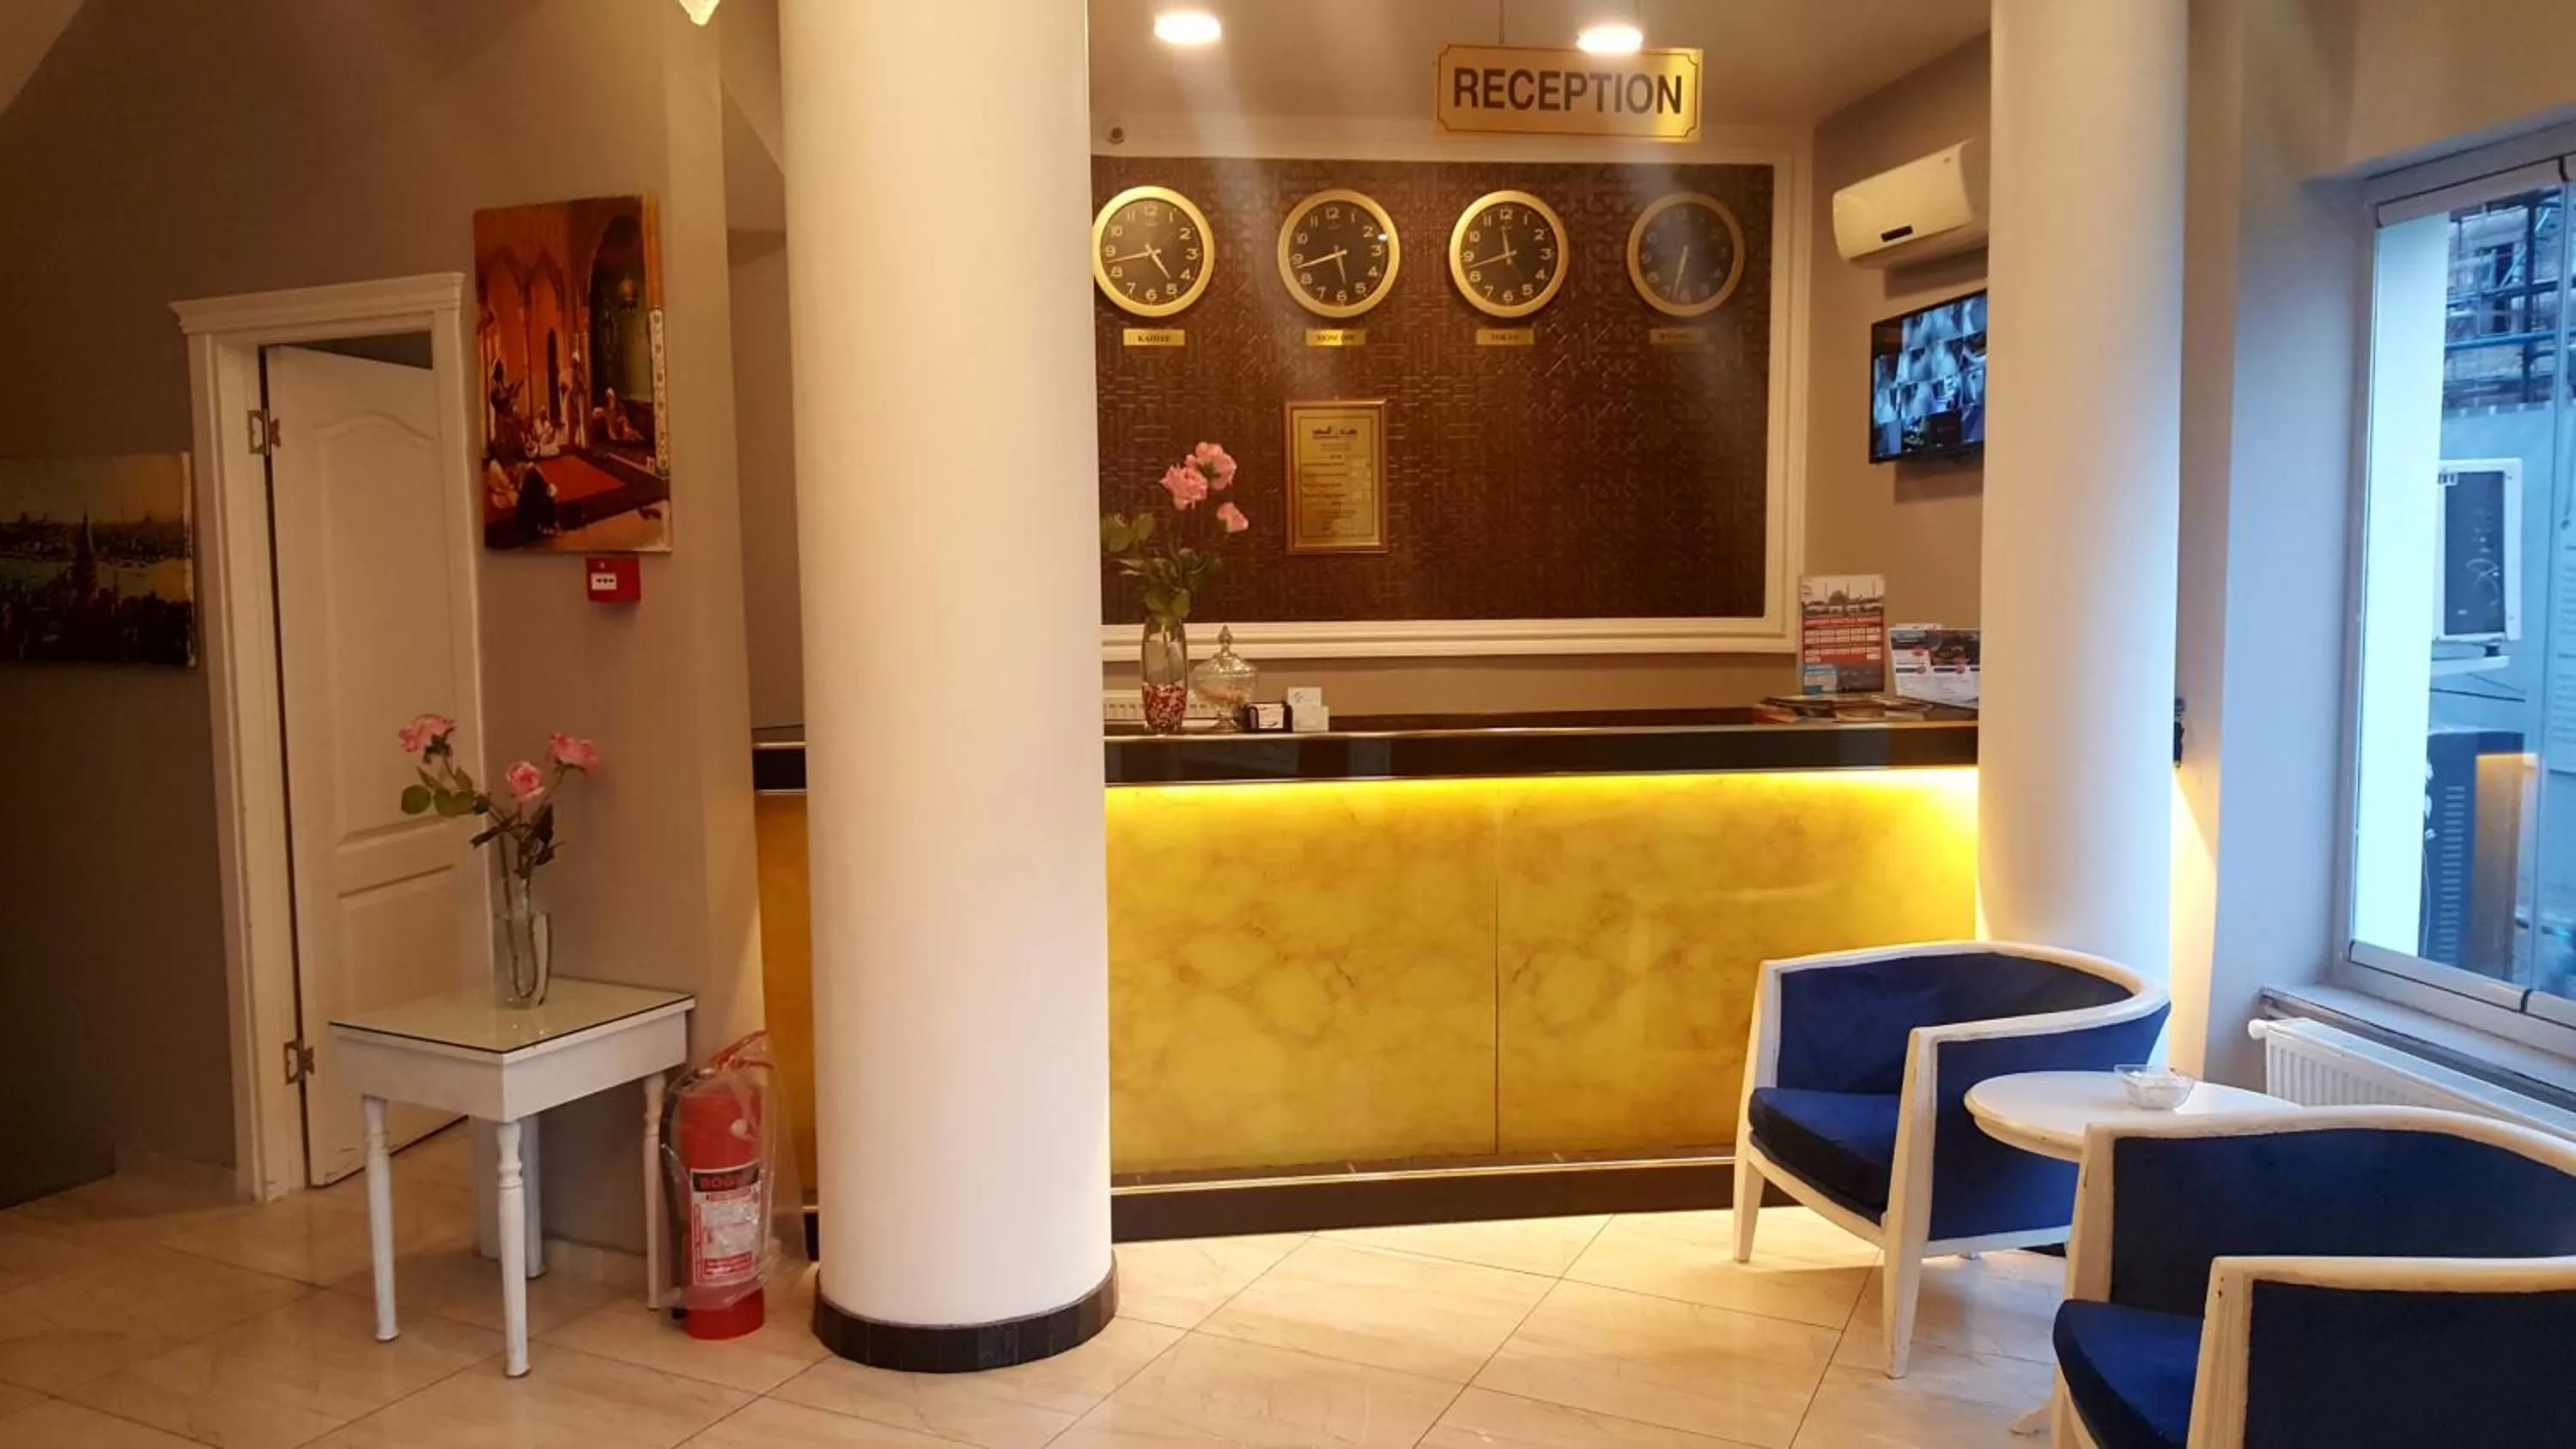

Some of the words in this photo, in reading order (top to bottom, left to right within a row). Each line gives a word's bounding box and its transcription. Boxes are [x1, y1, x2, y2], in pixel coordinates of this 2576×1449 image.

[1453, 67, 1682, 114] RECEPTION
[1326, 208, 1340, 219] 12
[1500, 209, 1512, 220] 12
[1180, 228, 1191, 239] 2
[1364, 227, 1374, 238] 2
[1469, 231, 1480, 242] 10
[1534, 229, 1544, 240] 2
[1297, 233, 1308, 245] 10
[1105, 246, 1115, 257] 9
[1187, 248, 1198, 259] 3
[1372, 246, 1382, 257] 3
[1463, 251, 1474, 262] 9
[1540, 249, 1552, 260] 3
[1291, 254, 1304, 264] 9
[1111, 267, 1122, 277] 8
[1181, 269, 1190, 280] 4
[1368, 266, 1377, 276] 4
[1470, 271, 1480, 282] 8
[1535, 269, 1545, 279] 4
[1301, 274, 1312, 284] 8
[1127, 282, 1136, 294] 7
[1166, 284, 1176, 294] 5
[1316, 287, 1327, 299] 7
[1355, 282, 1366, 294] 5
[1485, 286, 1494, 297] 7
[1522, 284, 1533, 295] 5
[1146, 288, 1157, 300] 6
[1336, 290, 1346, 300] 6
[1503, 290, 1514, 300] 6
